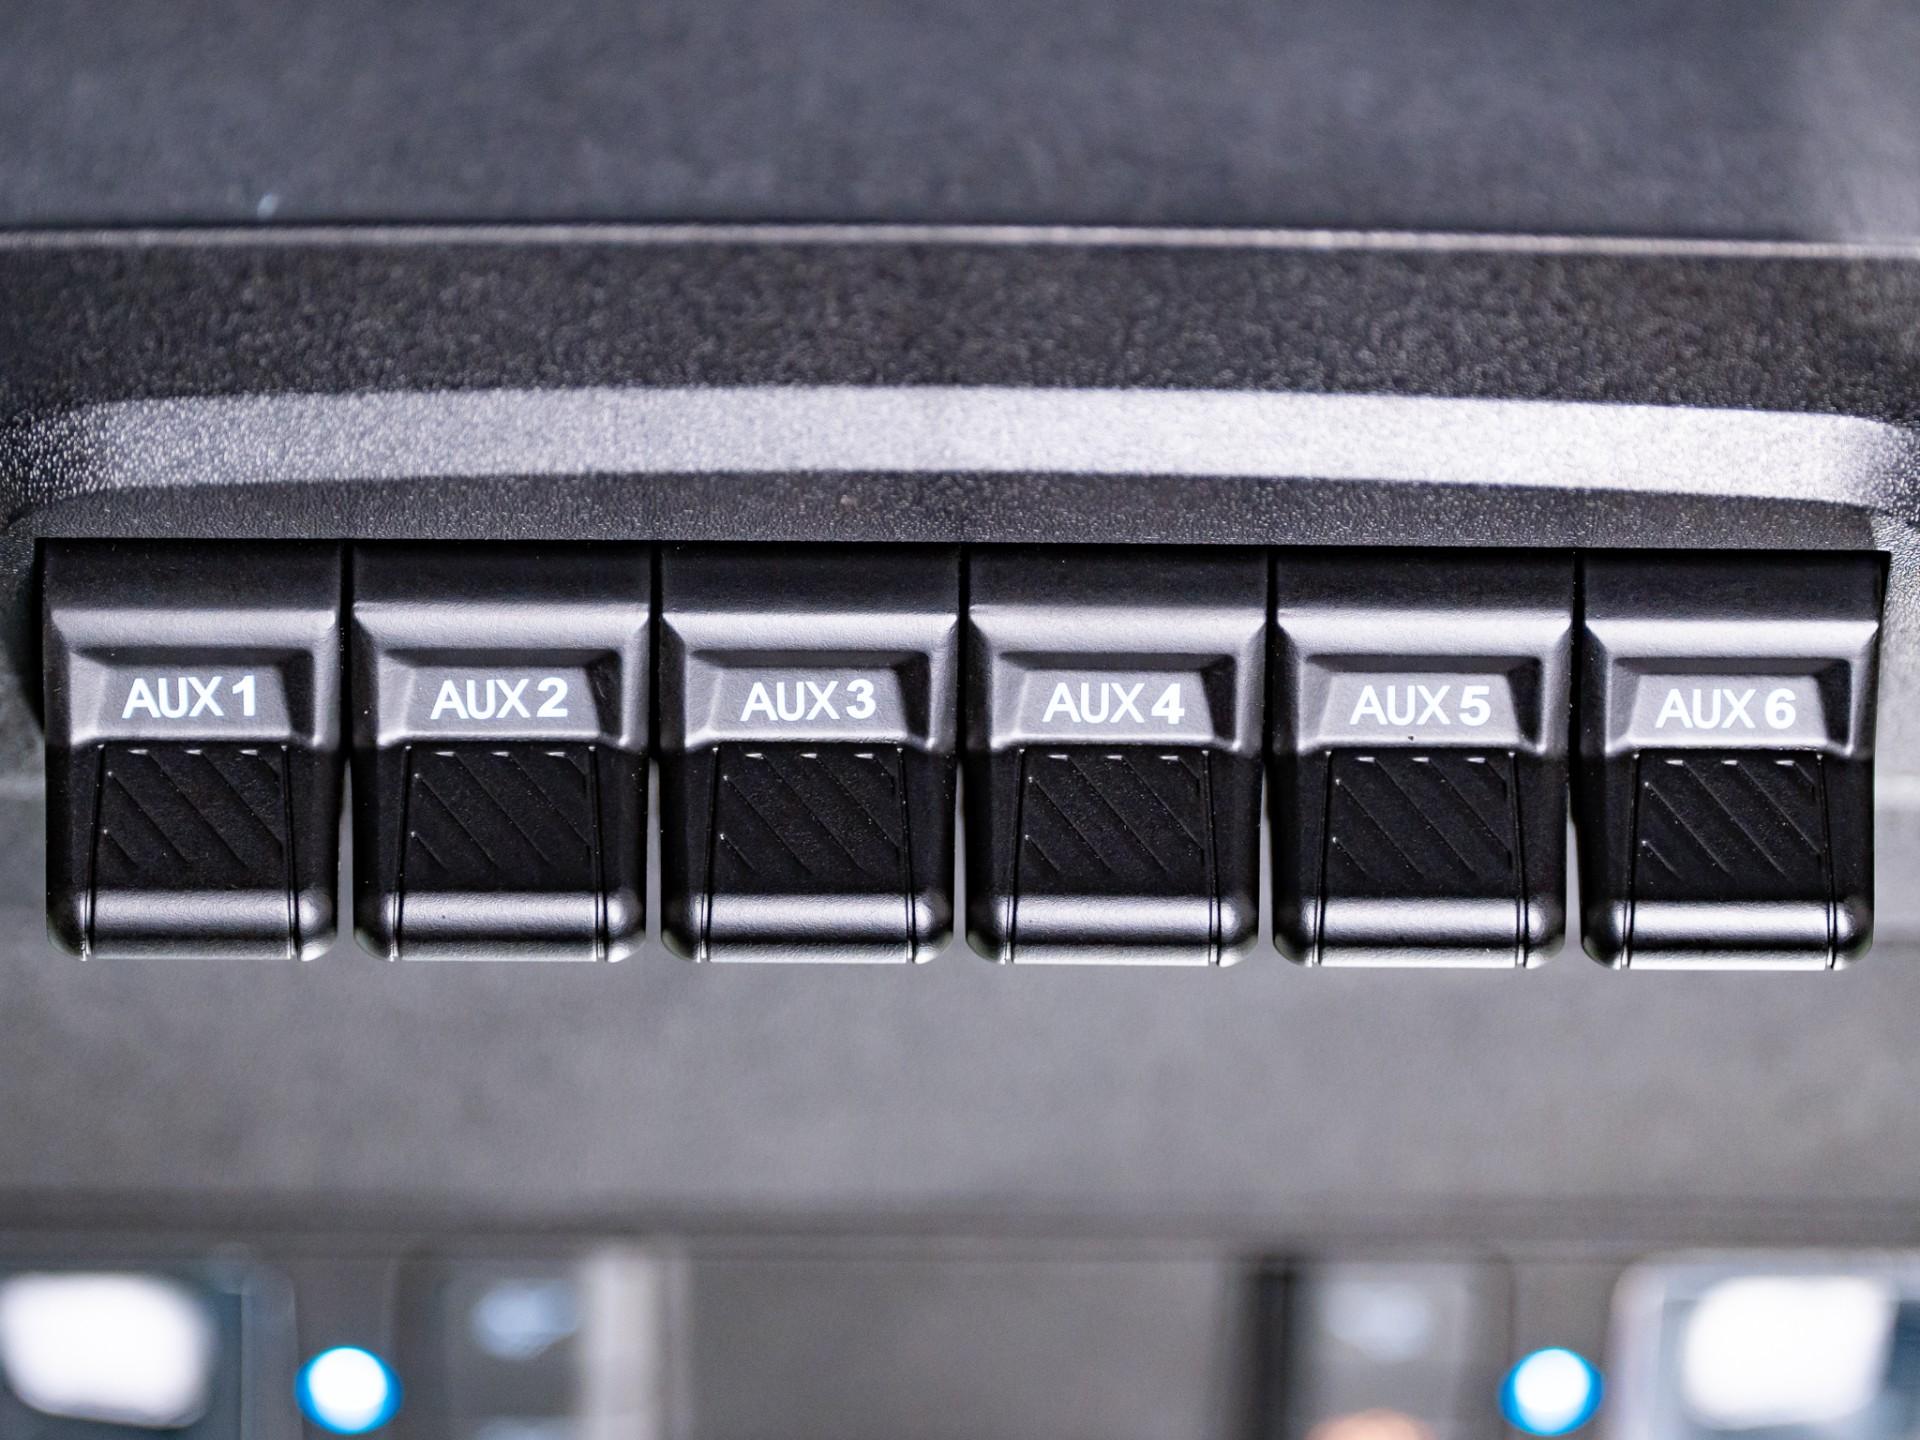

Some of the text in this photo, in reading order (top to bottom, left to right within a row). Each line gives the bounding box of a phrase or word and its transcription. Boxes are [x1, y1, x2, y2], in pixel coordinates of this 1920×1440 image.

[122, 676, 254, 718] AUX 1
[430, 677, 569, 720] AUX 2
[740, 679, 877, 721] AUX 3
[1042, 682, 1186, 724] AUX 4
[1349, 685, 1491, 726] AUX 5
[1655, 688, 1796, 729] AUX 6
